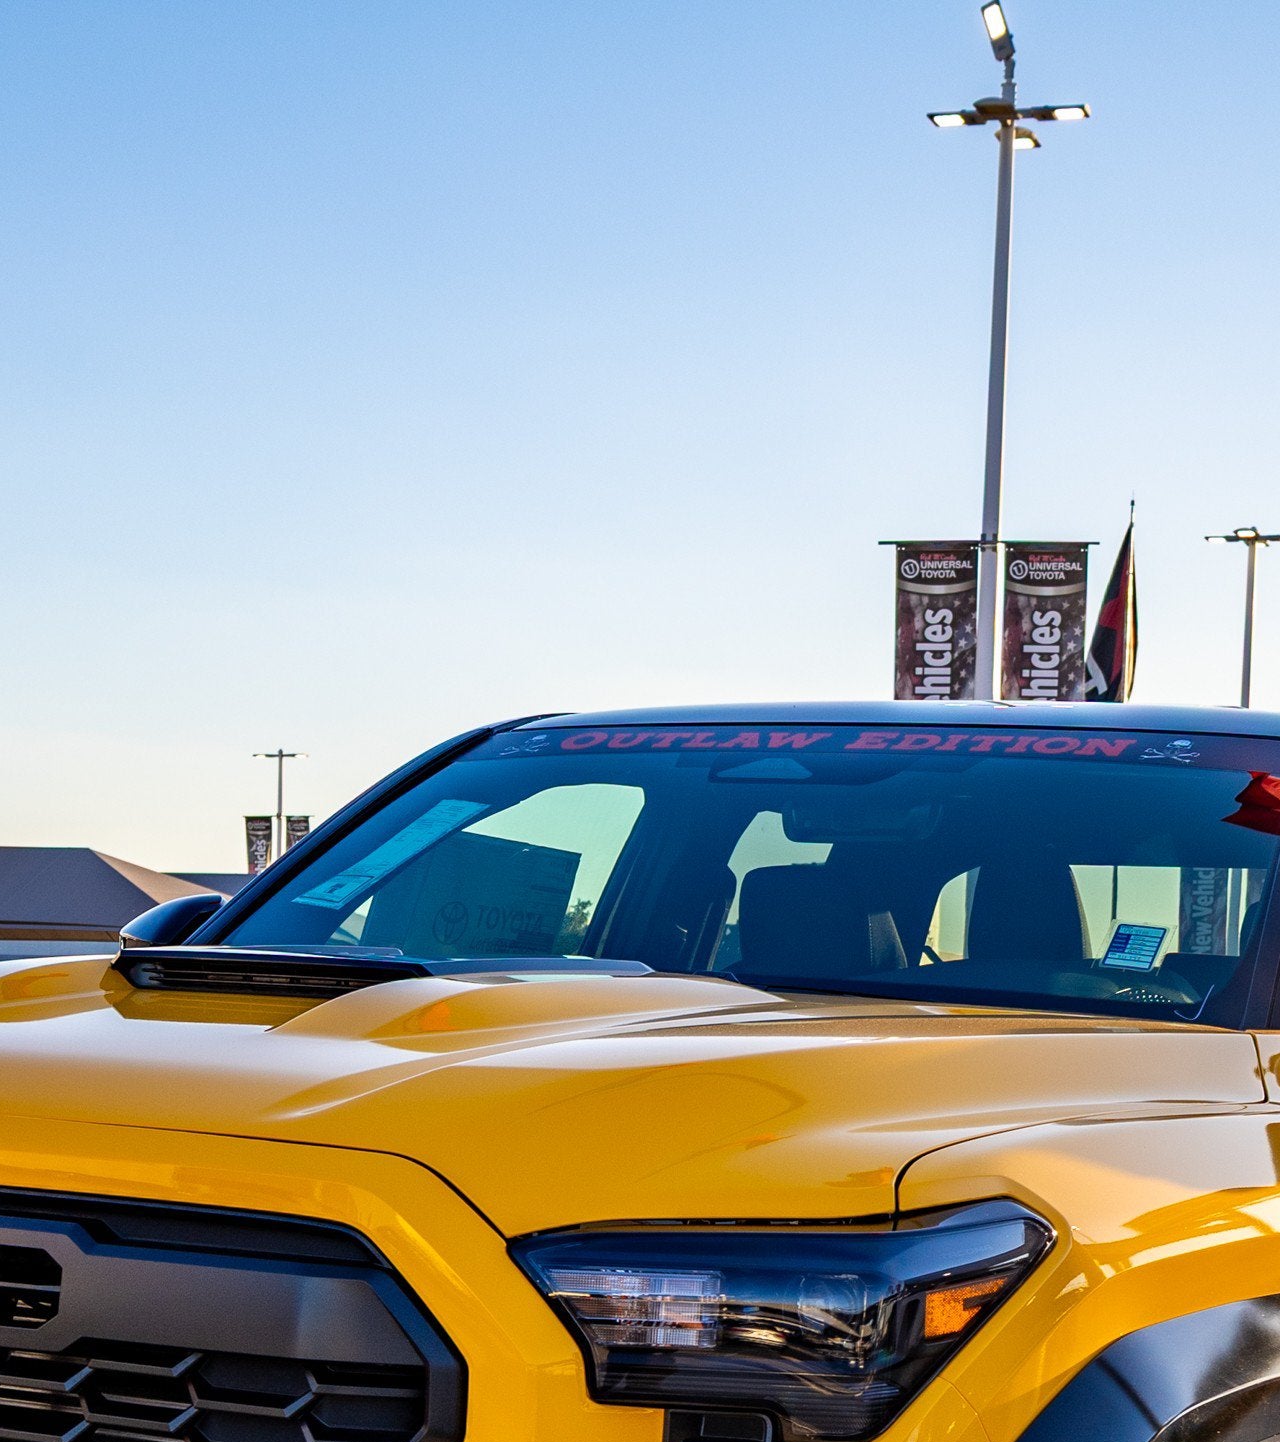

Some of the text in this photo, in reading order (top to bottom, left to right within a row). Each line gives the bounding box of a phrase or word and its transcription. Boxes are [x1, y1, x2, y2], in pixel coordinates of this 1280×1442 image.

[920, 560, 973, 569] UNIVERSAL
[920, 569, 957, 579] TOYOTA
[1029, 562, 1083, 571] UNIVERSAL
[1029, 571, 1066, 580] TOYOTA
[915, 608, 954, 700] hicles
[1021, 609, 1063, 700] hicles
[560, 731, 1138, 757] OUTLAW EDITION
[254, 839, 267, 873] hicles
[1191, 867, 1216, 918] Vehicl
